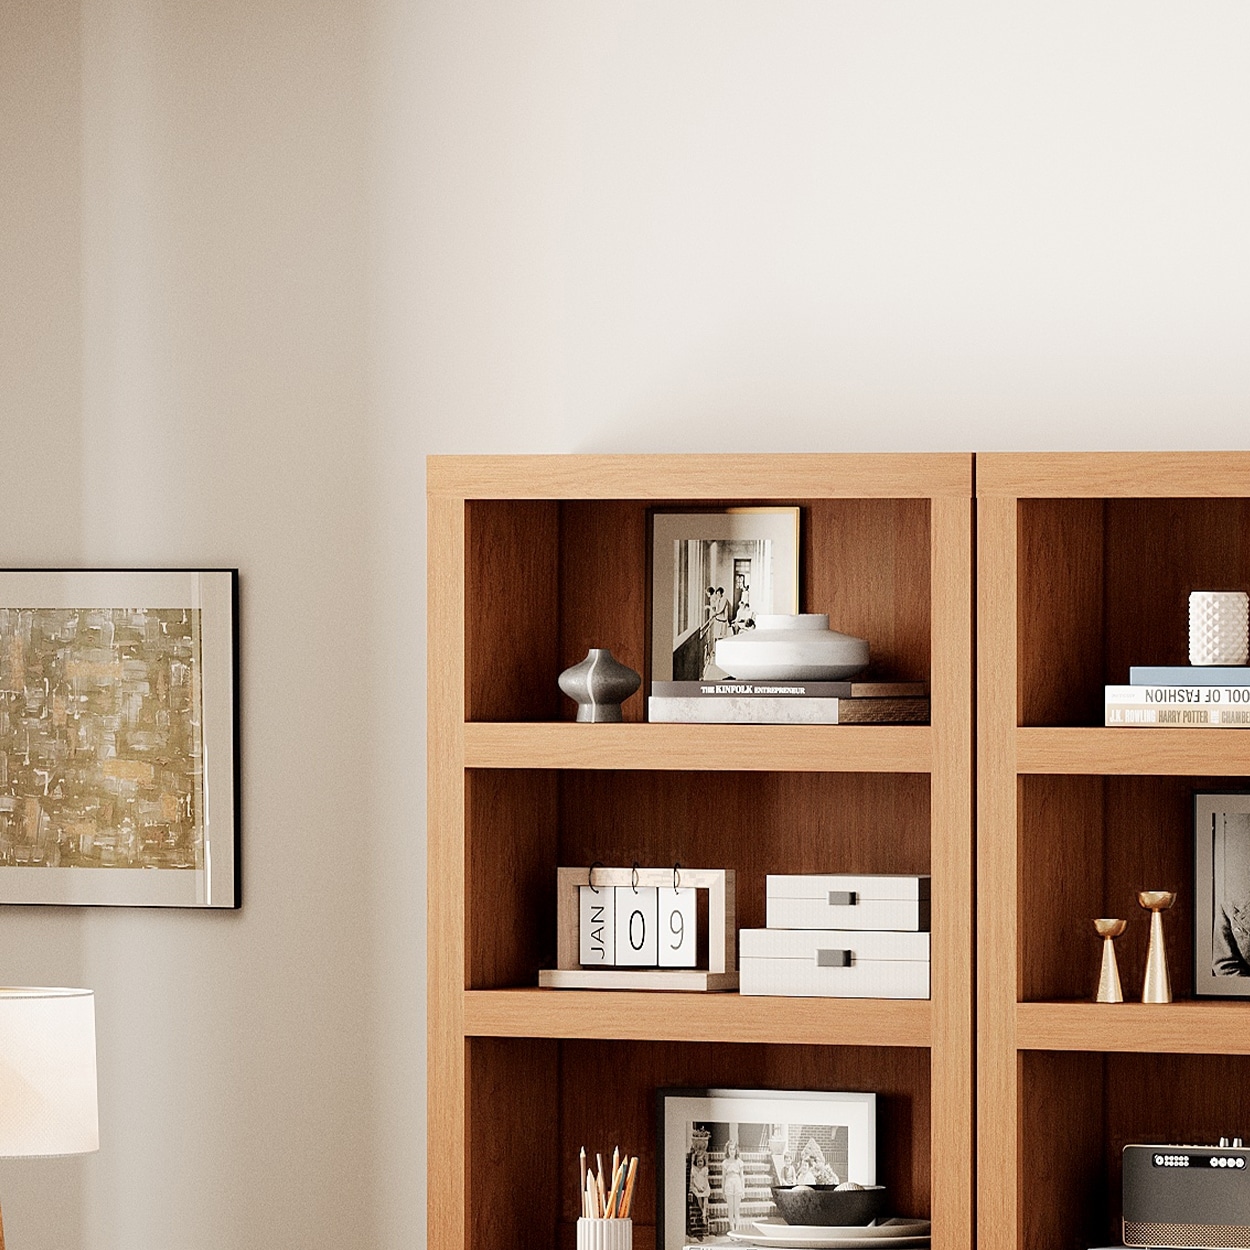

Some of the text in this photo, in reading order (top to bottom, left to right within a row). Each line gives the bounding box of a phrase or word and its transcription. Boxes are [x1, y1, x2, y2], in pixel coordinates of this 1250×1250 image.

[716, 684, 753, 694] KINFOLK
[754, 687, 806, 695] ENTREPRENEUR
[1145, 689, 1200, 703] FASHION
[1205, 689, 1221, 703] OF
[1125, 709, 1156, 723] ROWLING
[1159, 710, 1181, 723] HARRY
[1183, 711, 1209, 723] POTTER
[590, 906, 605, 959] JAN
